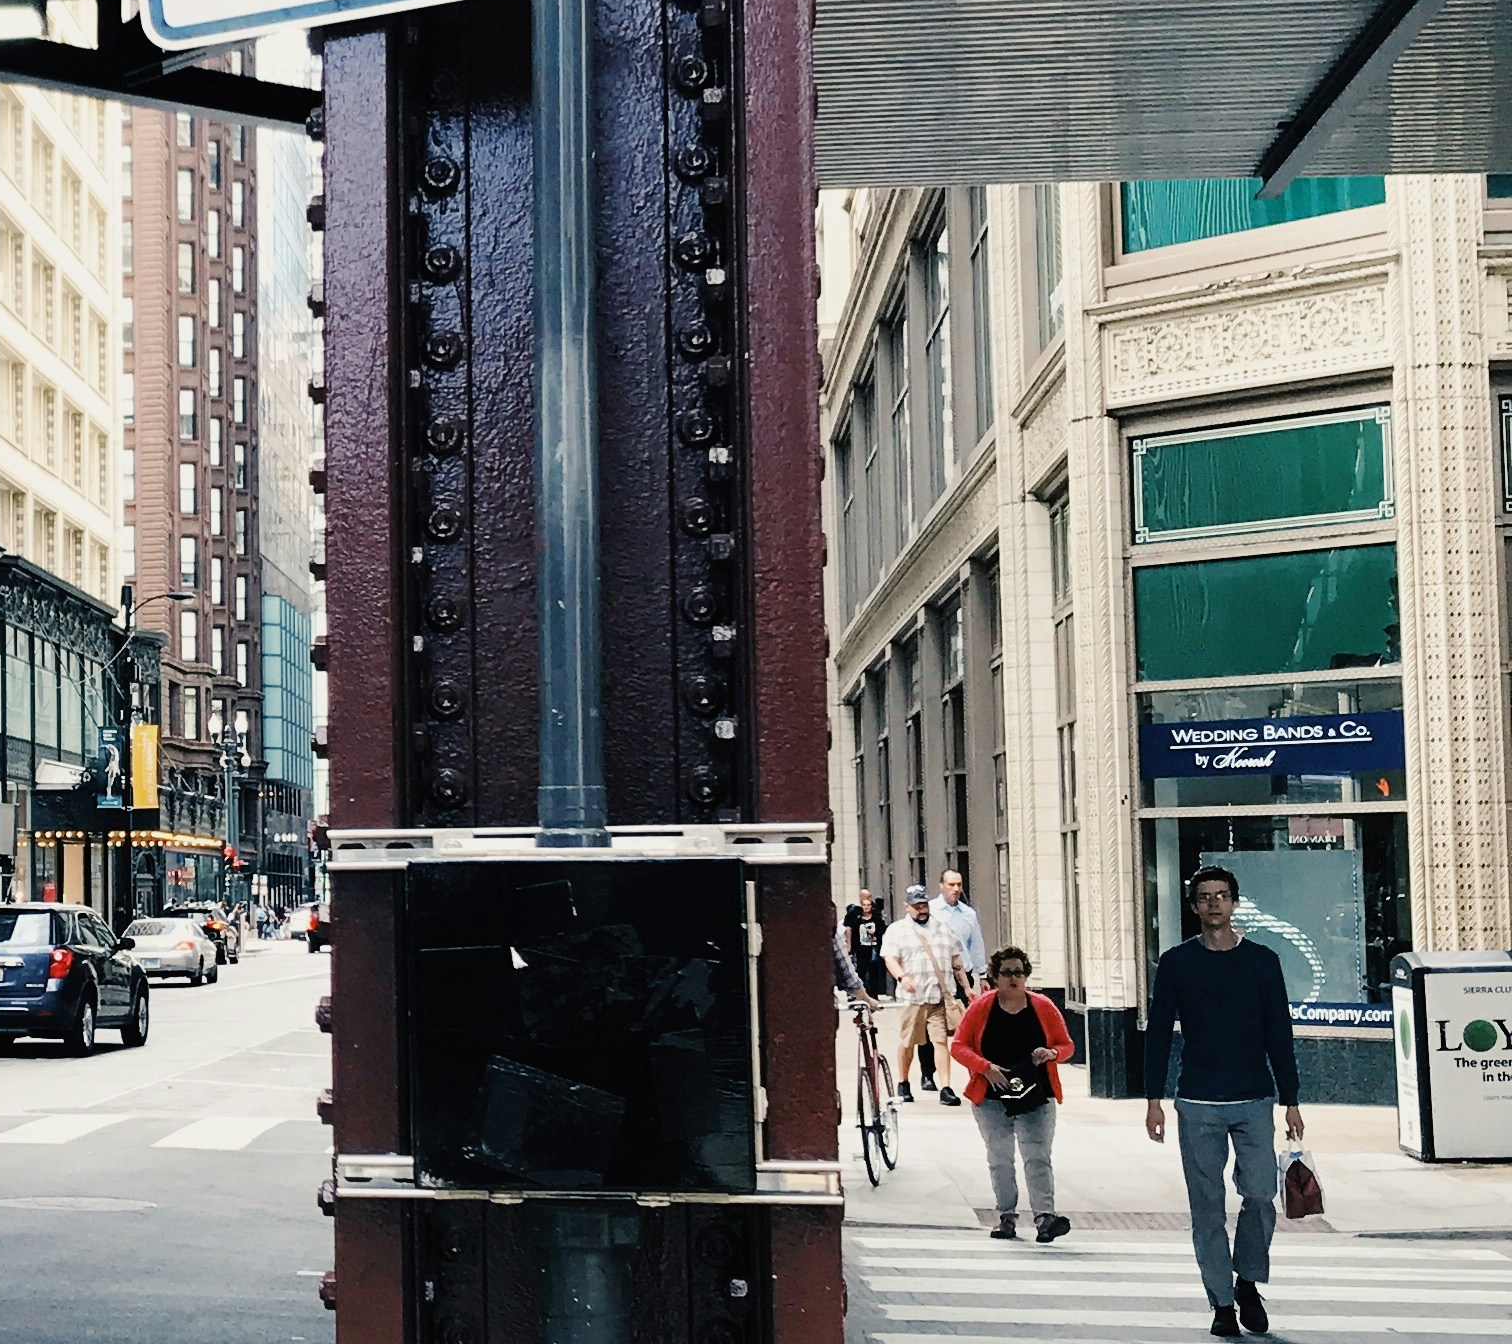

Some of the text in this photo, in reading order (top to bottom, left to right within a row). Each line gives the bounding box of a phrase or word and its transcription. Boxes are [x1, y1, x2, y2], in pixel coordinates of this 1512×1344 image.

[1171, 728, 1258, 744] WEDDING
[1263, 724, 1323, 740] BANDS
[1328, 728, 1336, 737] &
[1194, 753, 1209, 768] by
[1463, 986, 1493, 994] SIERRA
[1454, 1058, 1478, 1068] The
[1483, 1072, 1495, 1082] in
